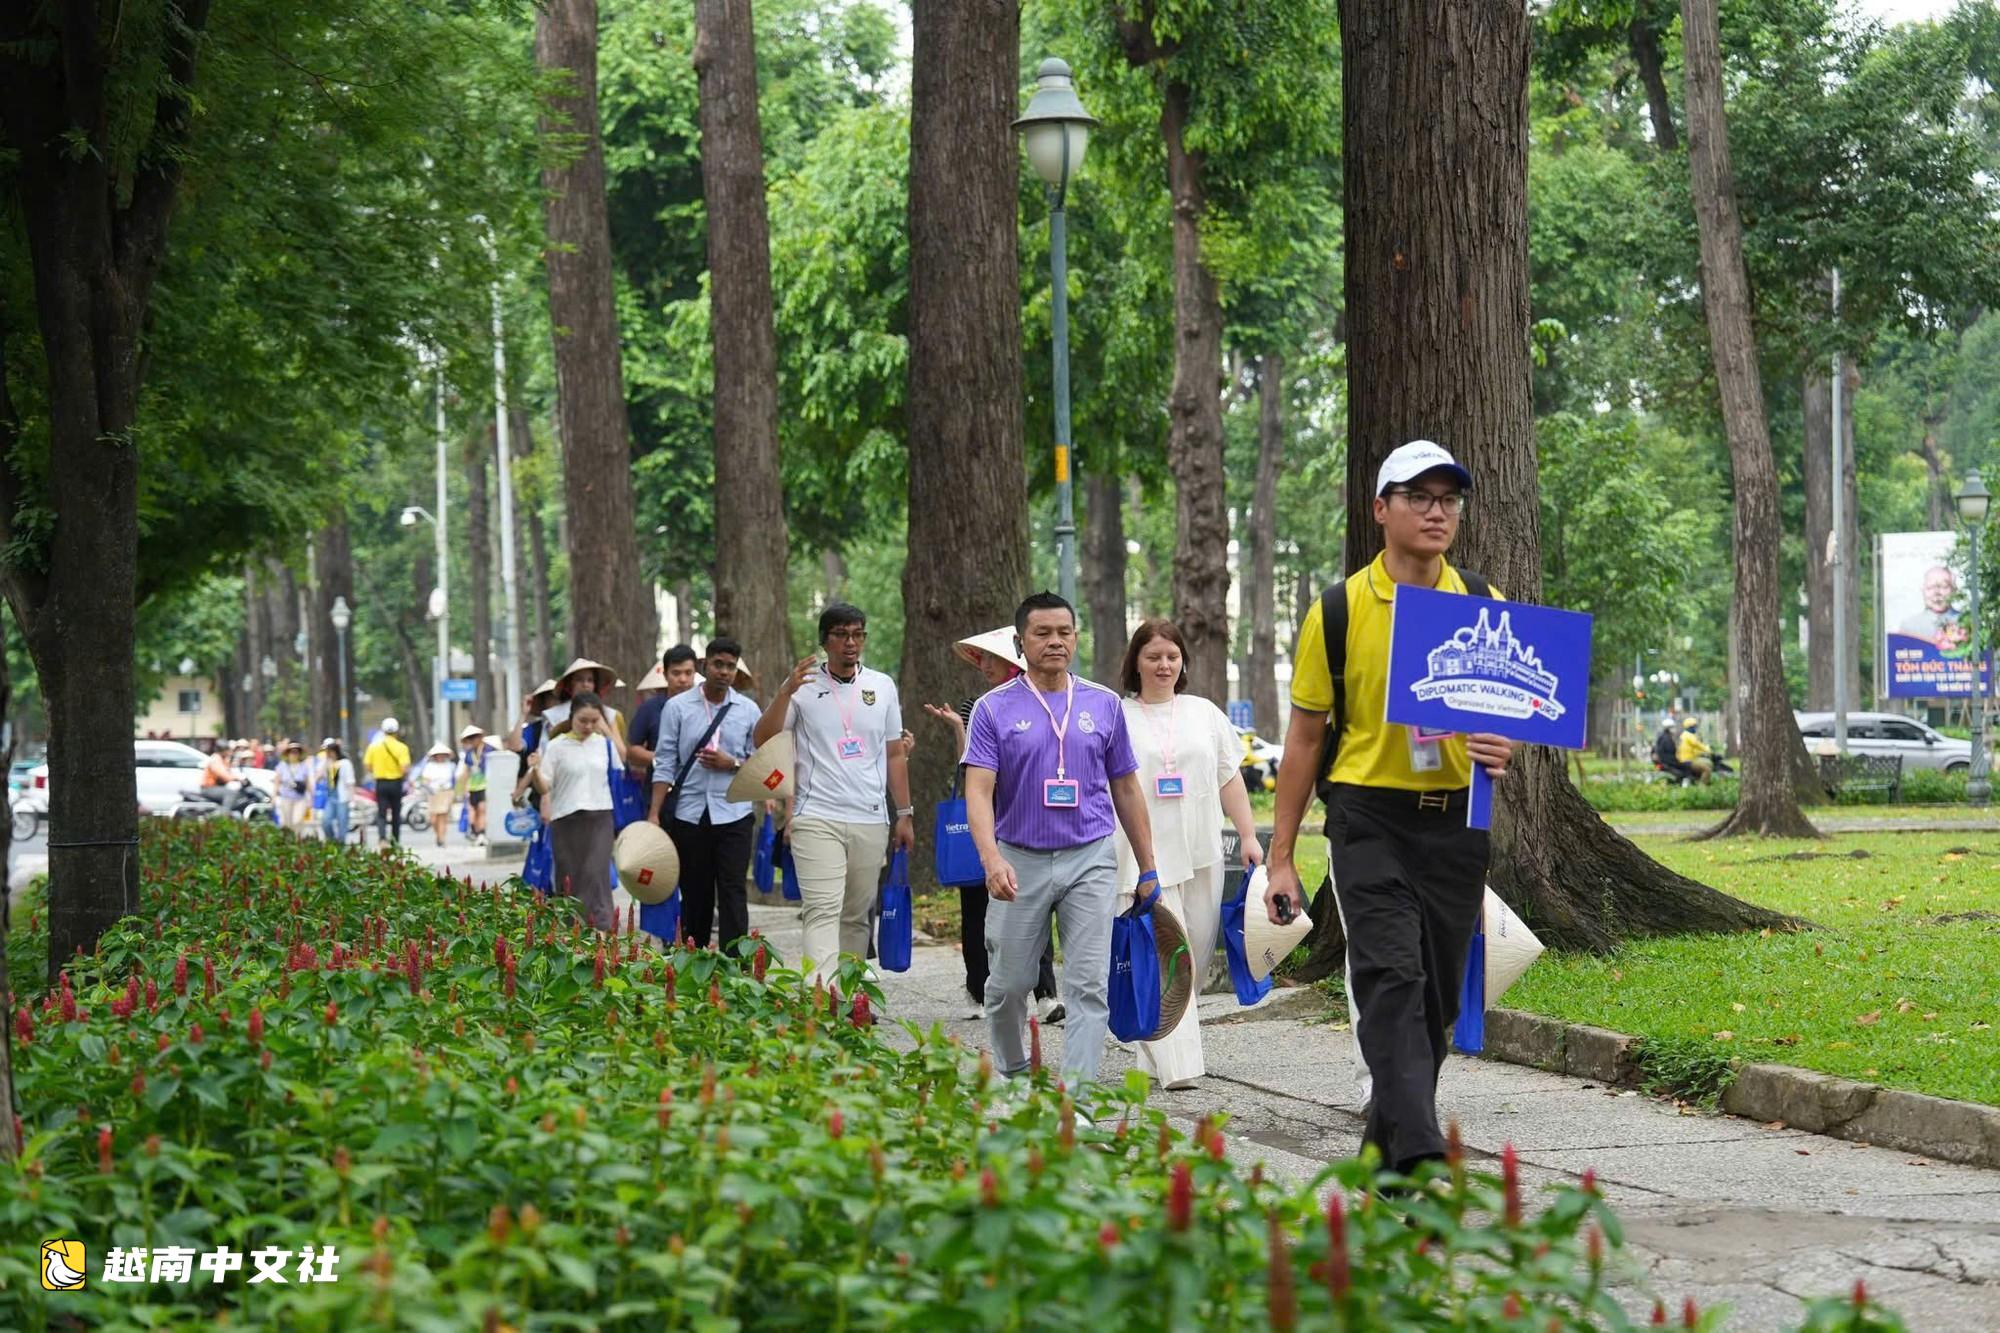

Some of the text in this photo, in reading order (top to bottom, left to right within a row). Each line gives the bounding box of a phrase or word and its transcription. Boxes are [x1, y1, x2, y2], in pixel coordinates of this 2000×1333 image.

[1419, 683, 1558, 718] DIPLOMATIC WALKING TOURS
[1447, 696, 1484, 709] Organized
[1486, 701, 1496, 711] by
